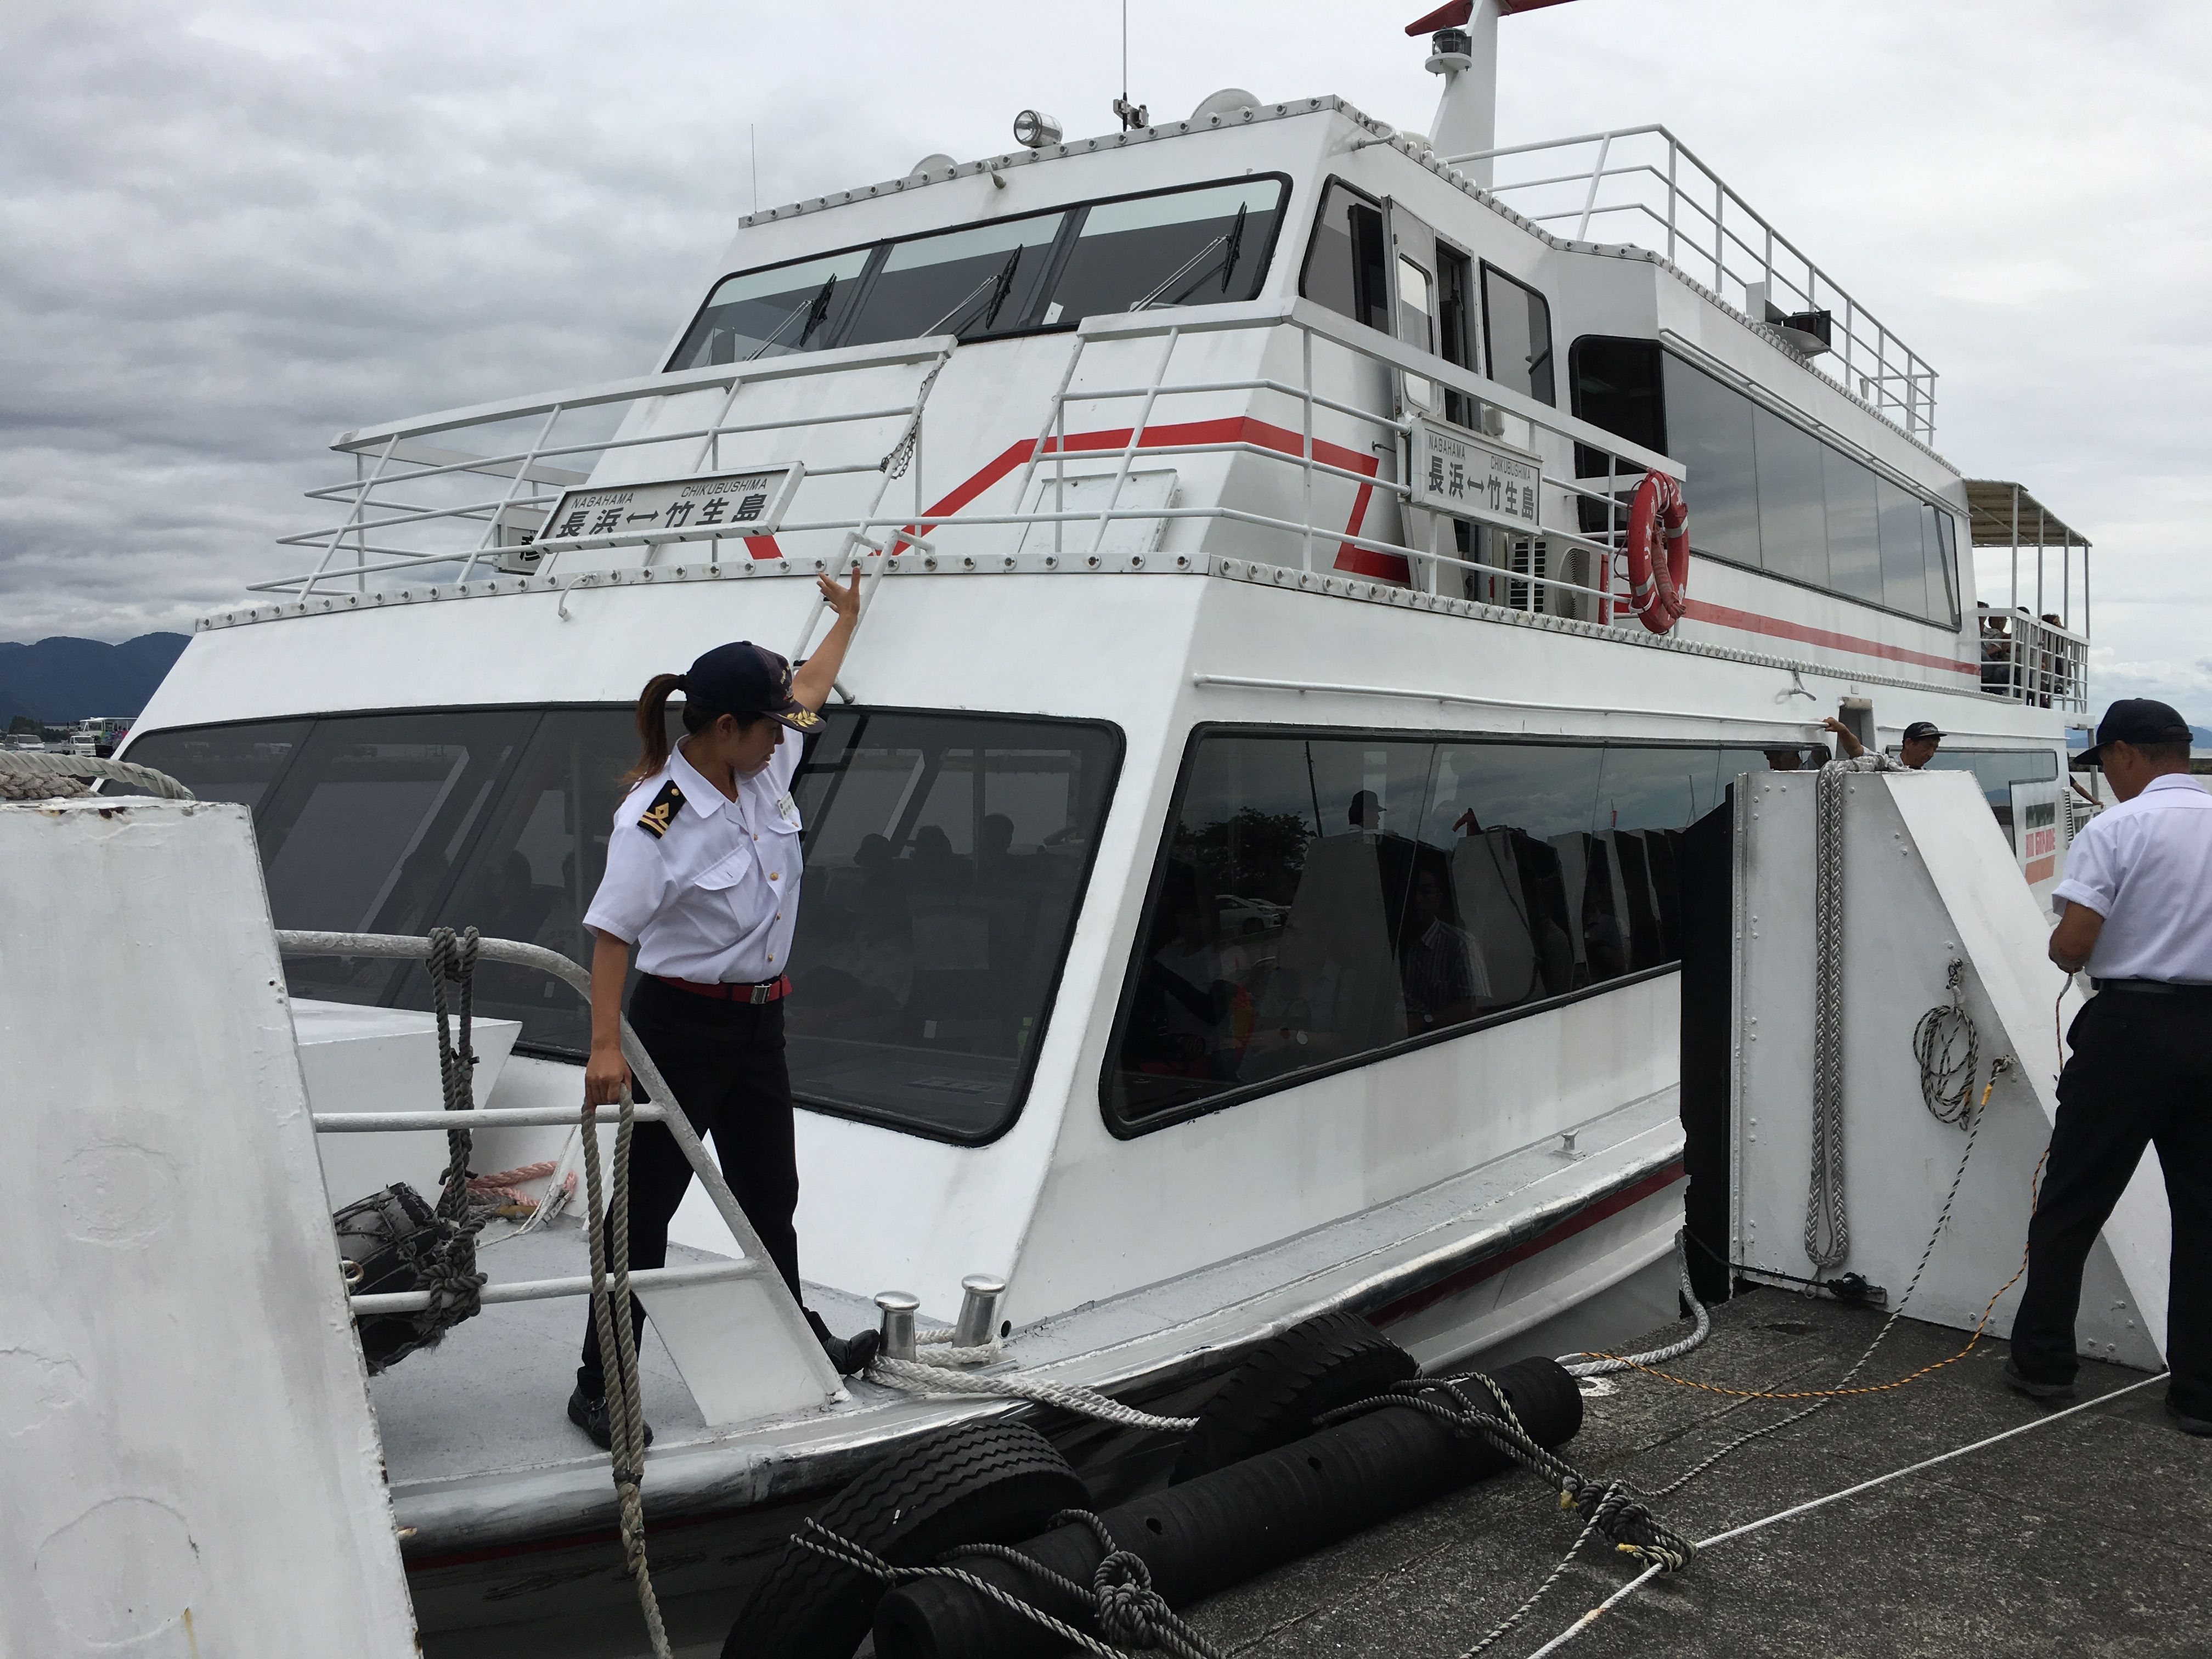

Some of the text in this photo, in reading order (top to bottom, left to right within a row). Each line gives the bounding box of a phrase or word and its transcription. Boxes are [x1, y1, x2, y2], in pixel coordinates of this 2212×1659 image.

[1429, 434, 1531, 481] NAGAHAMA CHIKUBUSHIMA
[571, 478, 768, 509] NAGAHAMA CHIKUBUSHIMA
[1429, 455, 1534, 521] 長浜 竹生島
[555, 494, 768, 538] 長浜 竹生島
